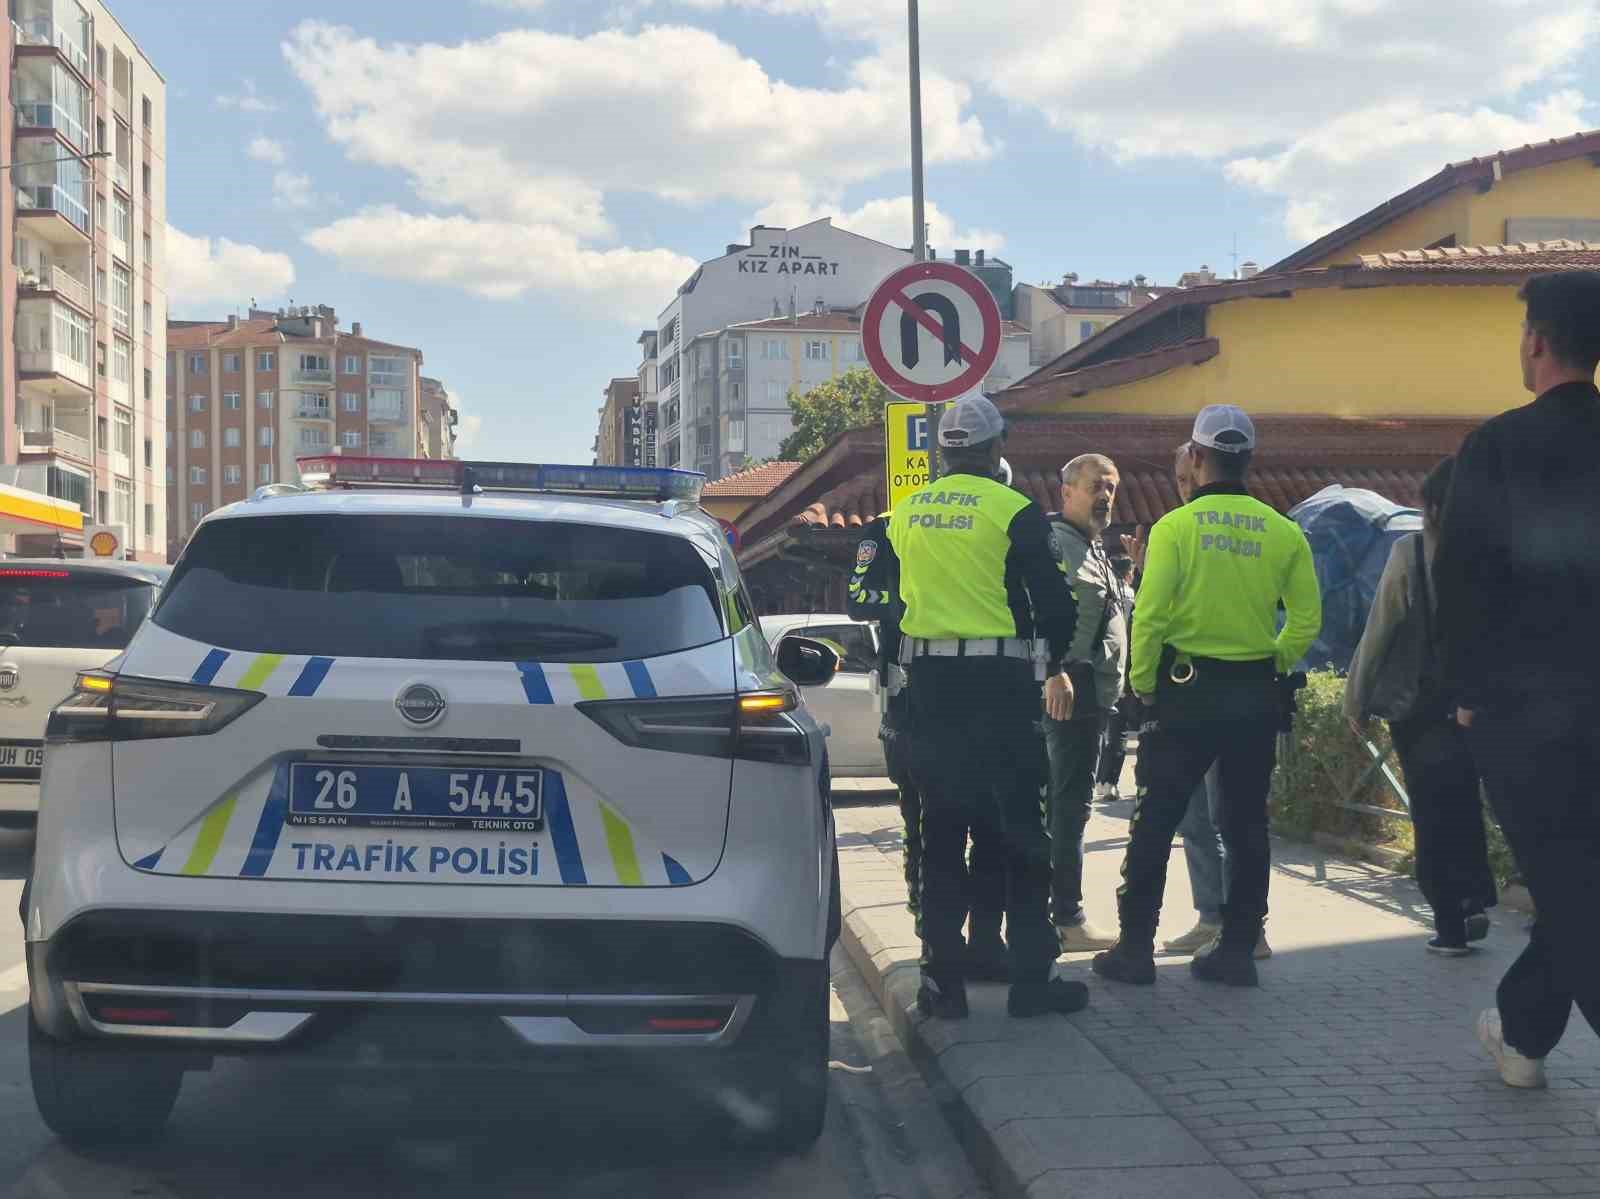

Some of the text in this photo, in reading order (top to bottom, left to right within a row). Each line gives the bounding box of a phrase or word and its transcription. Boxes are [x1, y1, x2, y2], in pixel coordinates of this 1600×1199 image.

[738, 260, 839, 275] KIZ APART
[906, 457, 929, 469] KA
[895, 474, 929, 487] OTOP
[314, 770, 536, 814] 26 A 5445
[292, 815, 348, 825] NISSAN
[513, 821, 535, 830] OTO
[291, 839, 539, 875] TRAFİK POLİSİ
